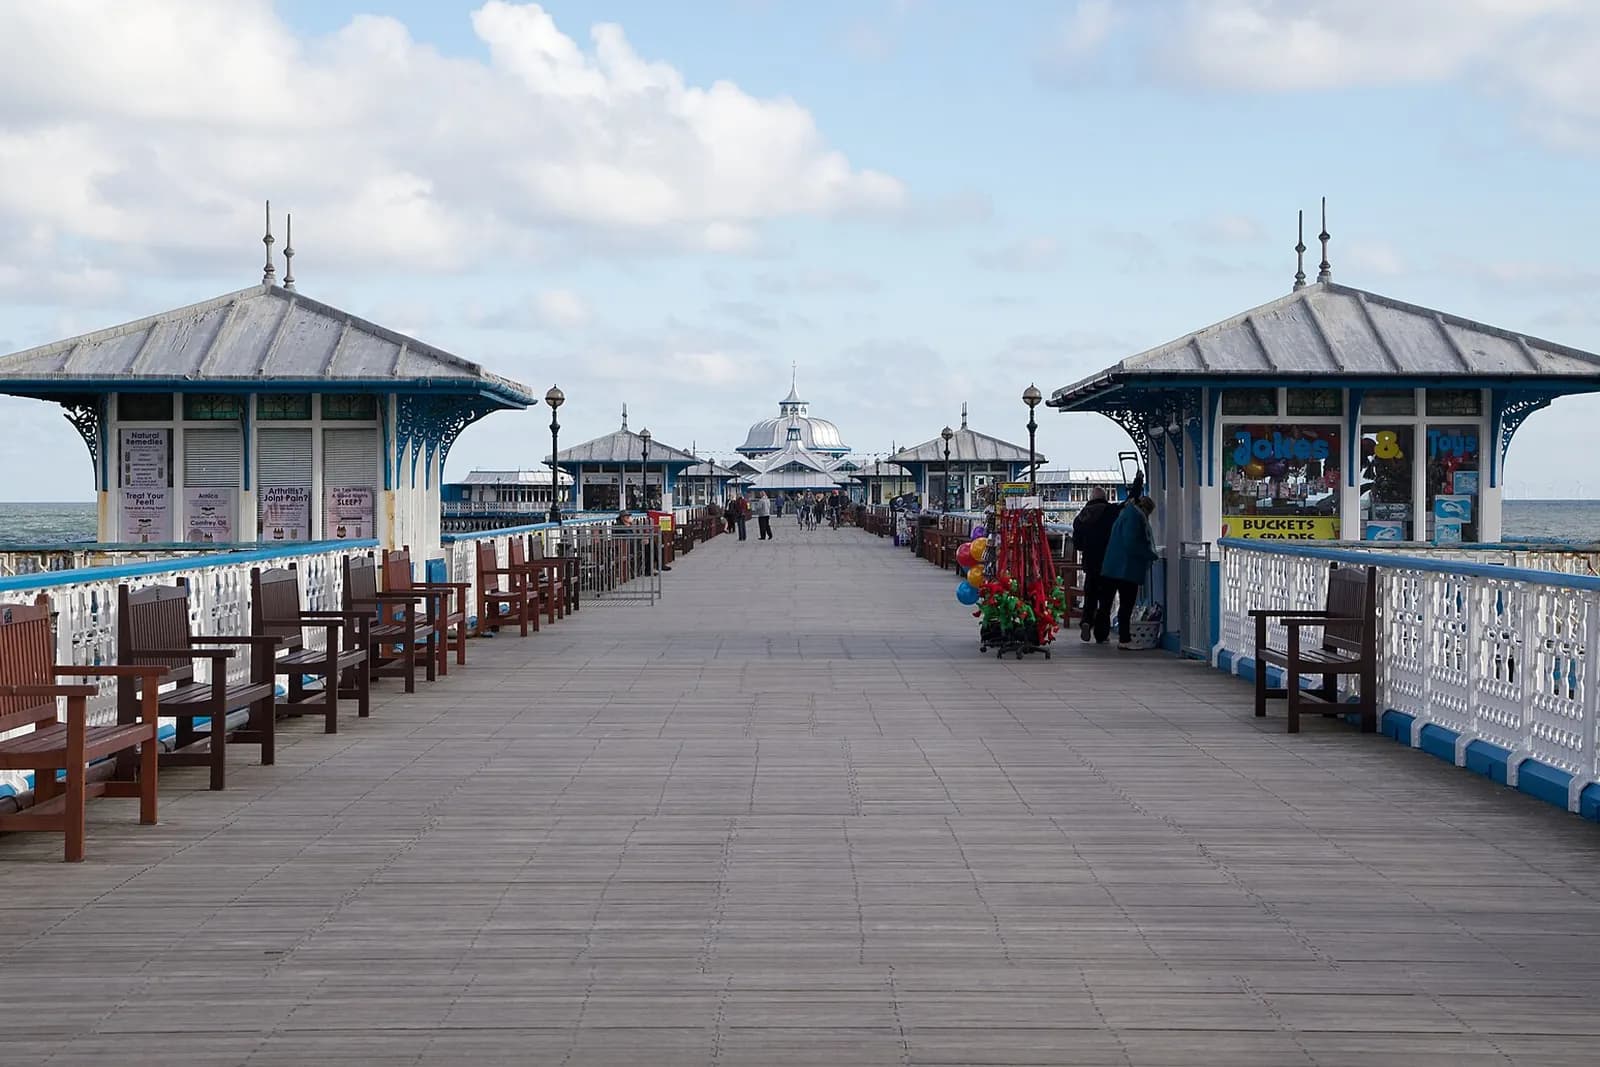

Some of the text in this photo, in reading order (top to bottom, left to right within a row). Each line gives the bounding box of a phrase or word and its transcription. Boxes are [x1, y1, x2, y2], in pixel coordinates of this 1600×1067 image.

[1233, 428, 1476, 466] Jokes & Toys
[1243, 520, 1315, 530] BUCKETS
